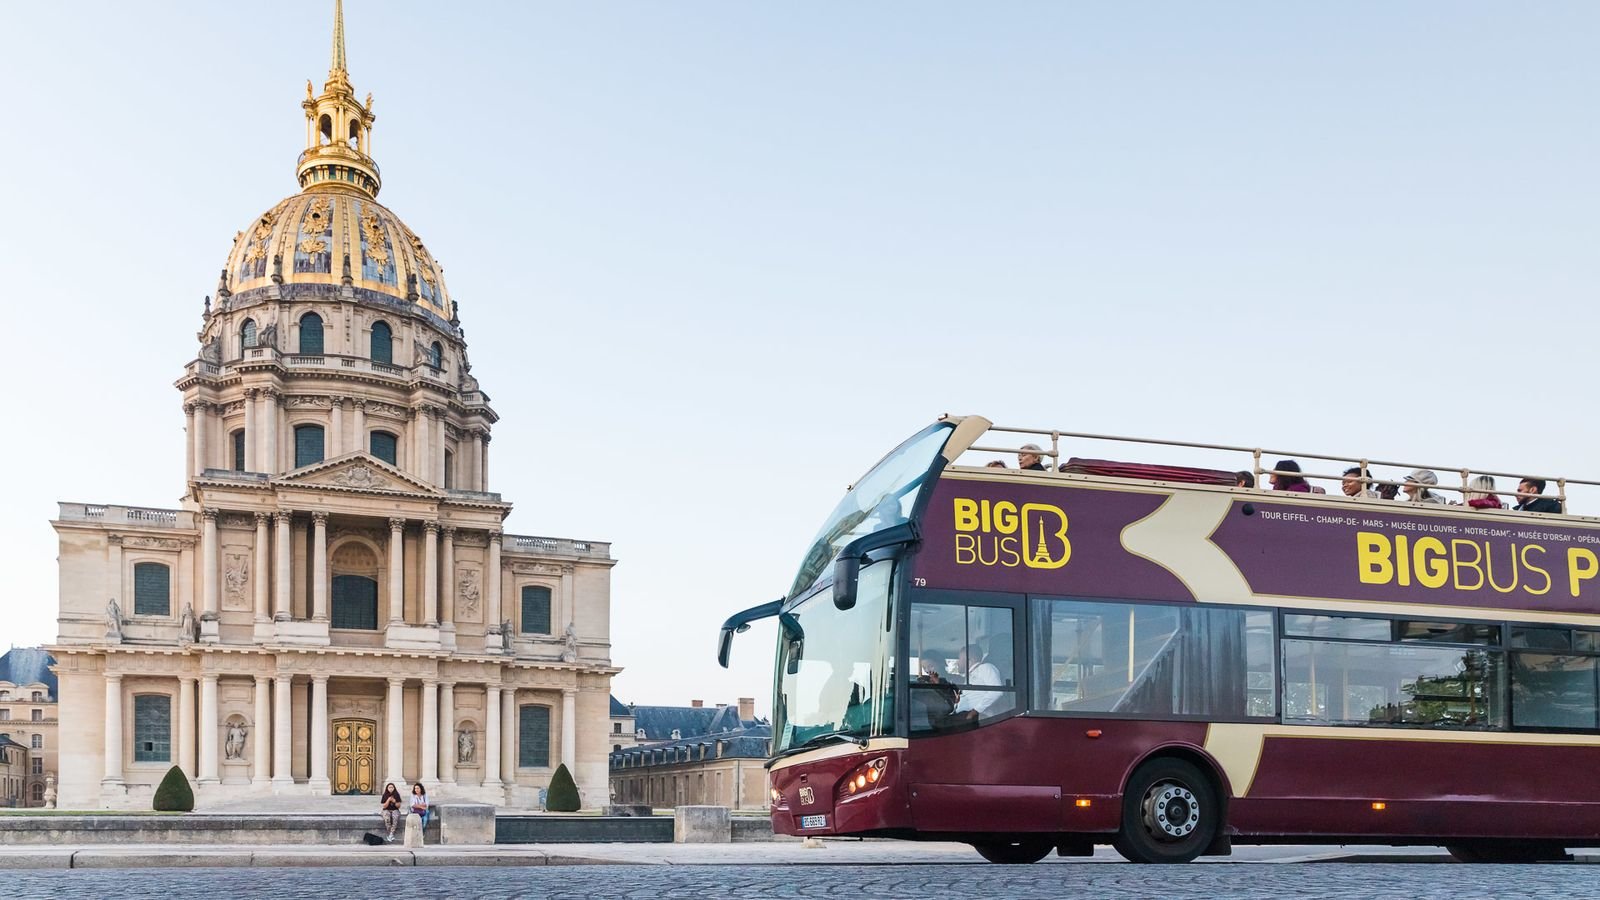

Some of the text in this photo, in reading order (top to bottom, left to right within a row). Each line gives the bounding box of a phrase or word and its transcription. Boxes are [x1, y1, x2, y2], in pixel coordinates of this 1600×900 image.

[954, 498, 1018, 534] BIG
[1261, 510, 1281, 520] TOUR
[1283, 512, 1309, 522] EIFFEL
[1363, 519, 1384, 528] MARS
[1391, 520, 1416, 531] MUSÉE
[1418, 523, 1428, 532] DU
[1430, 524, 1458, 534] LOUVRE
[1518, 529, 1542, 540] MUSÉE
[1543, 532, 1571, 542] D'ORSAY
[956, 534, 1020, 567] BUS
[914, 578, 926, 586] 79
